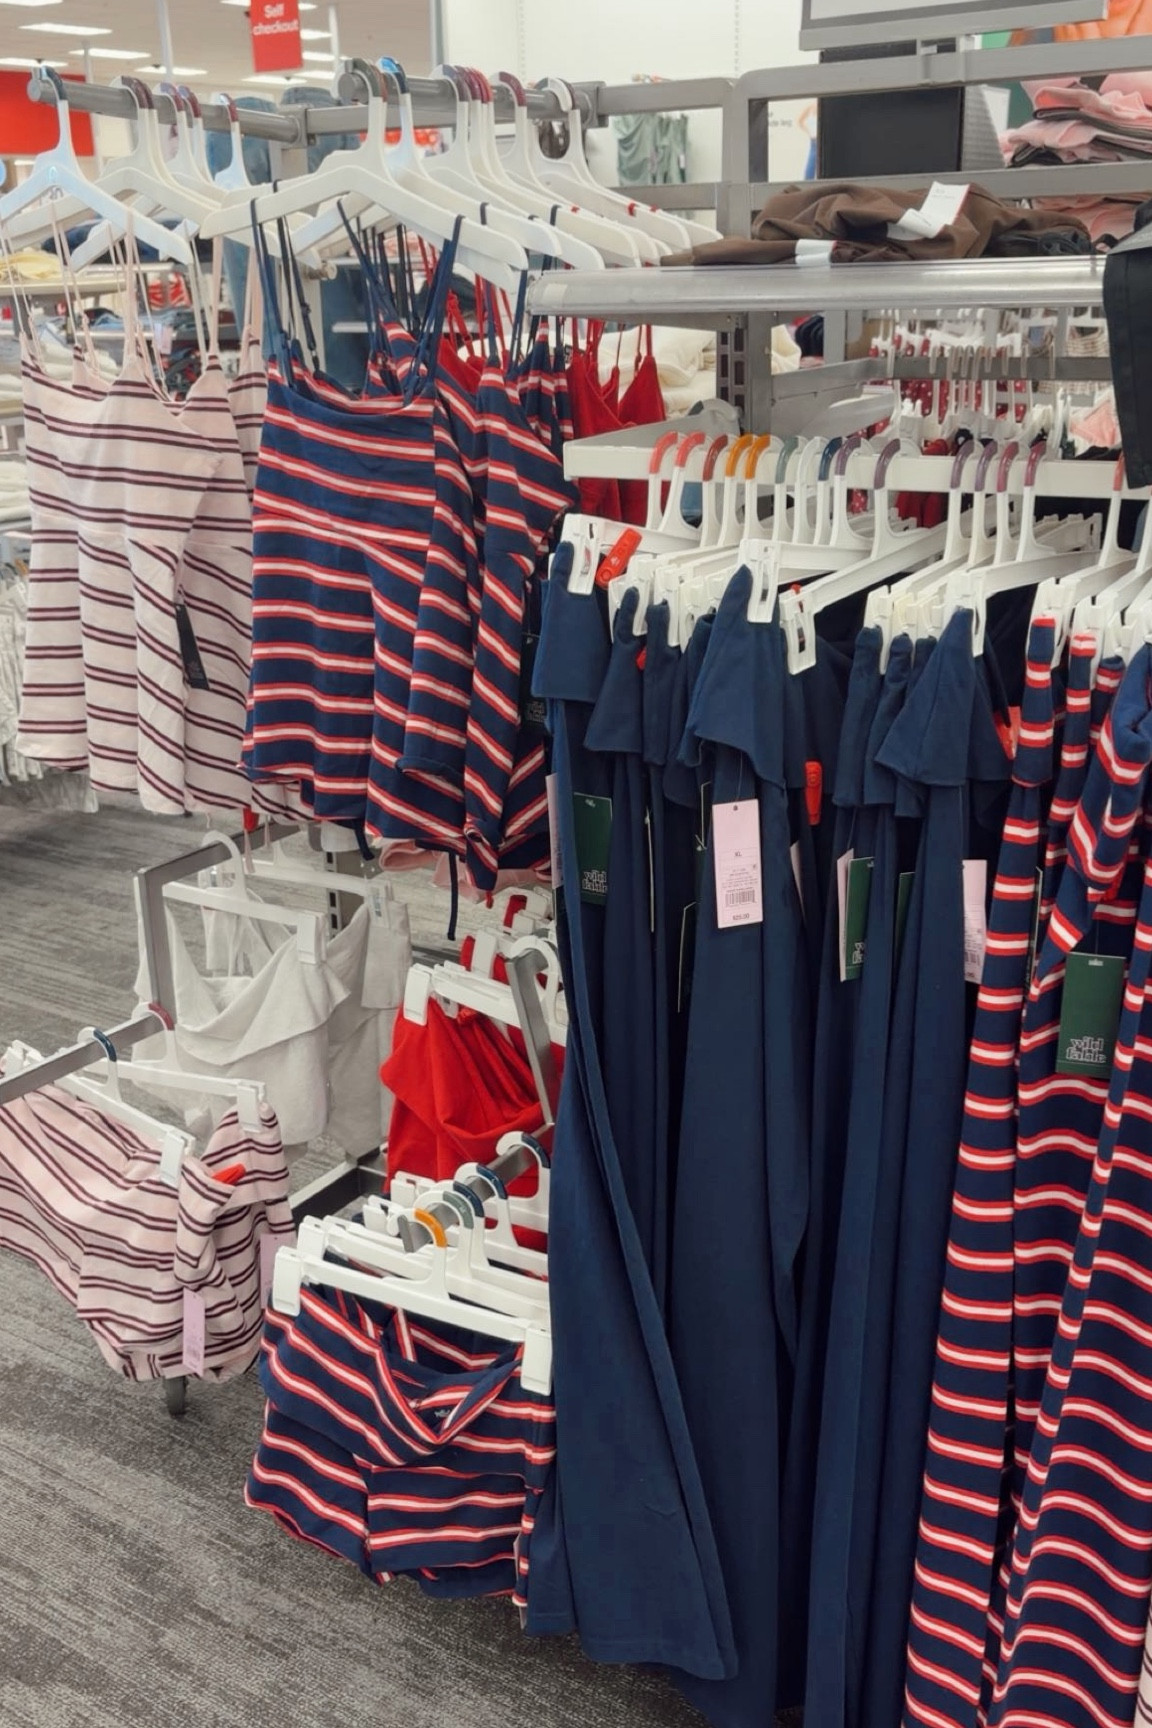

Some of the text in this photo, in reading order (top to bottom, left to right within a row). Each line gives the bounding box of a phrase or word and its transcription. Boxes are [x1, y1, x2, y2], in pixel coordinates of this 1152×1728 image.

[264, 3, 285, 19] Self
[252, 19, 299, 36] checkout
[1070, 1036, 1105, 1051] wild
[1065, 1046, 1107, 1064] fable
